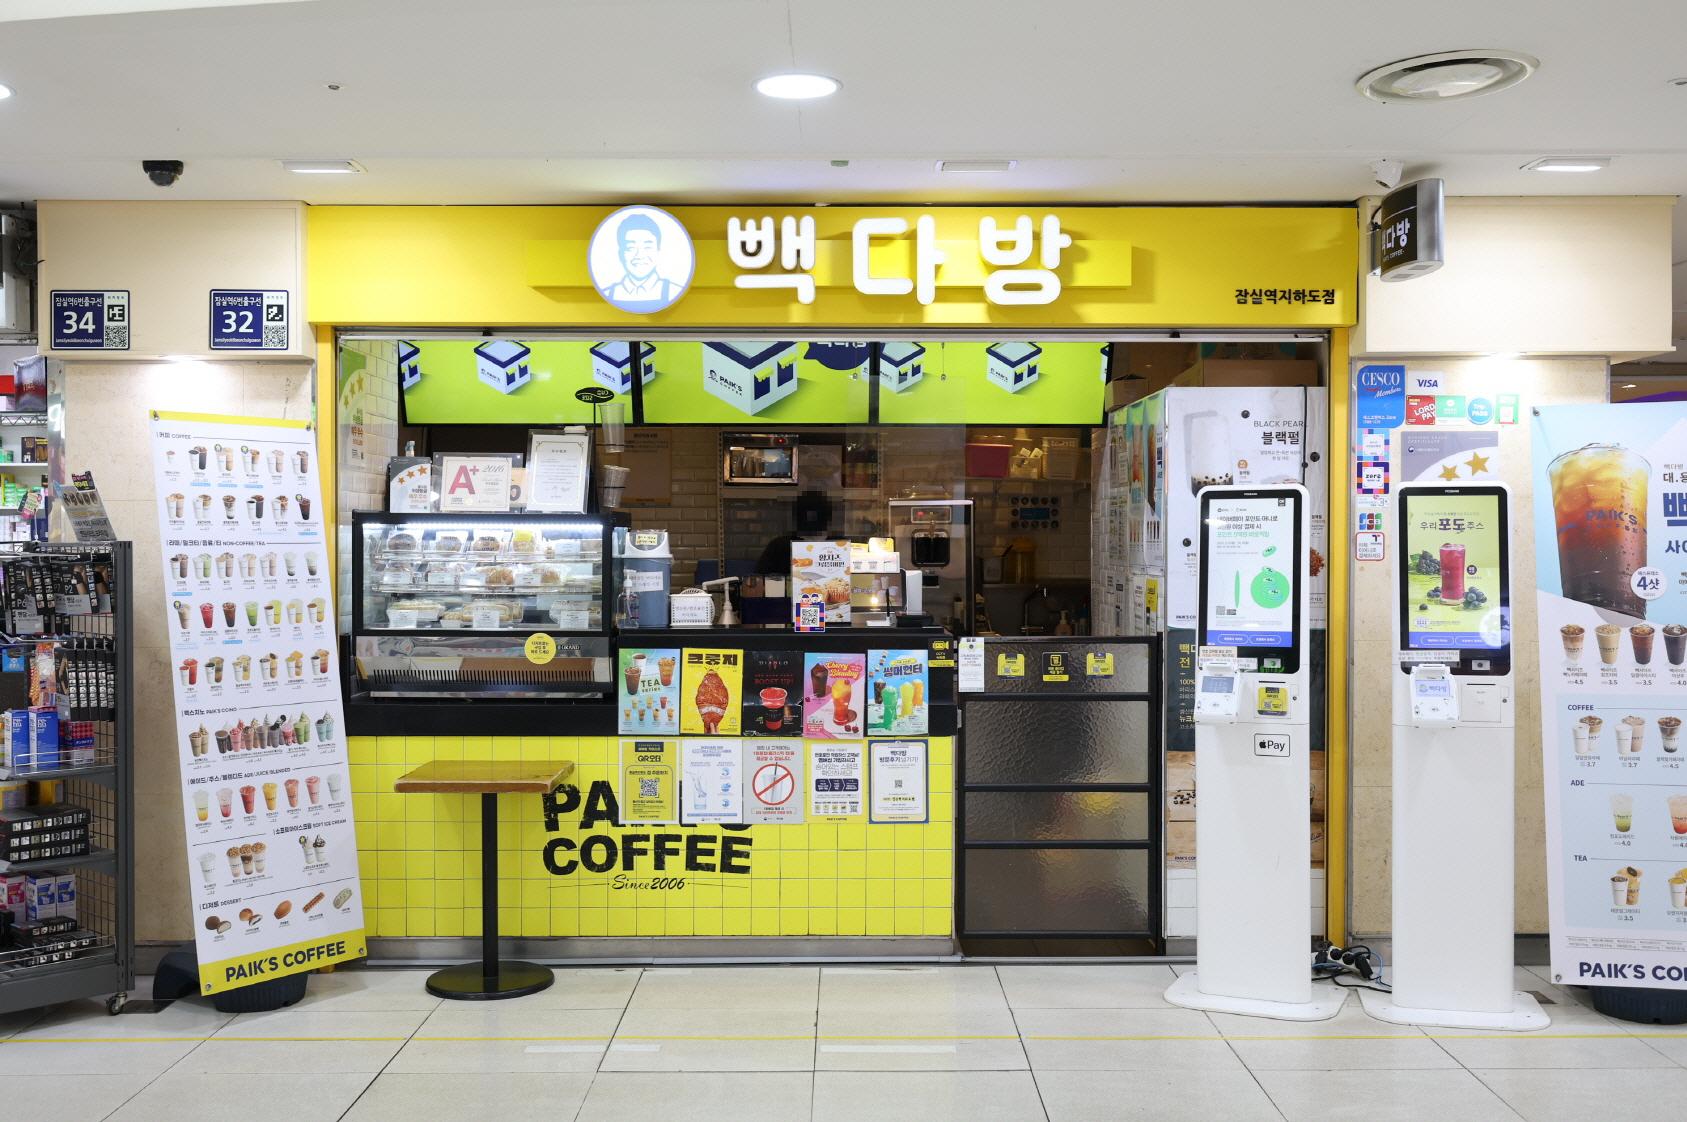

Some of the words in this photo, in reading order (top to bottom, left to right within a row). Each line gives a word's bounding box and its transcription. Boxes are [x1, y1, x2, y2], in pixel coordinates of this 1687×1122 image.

[728, 214, 1072, 305] 빽다방
[1235, 289, 1335, 304] 잠실역지하도점
[63, 311, 96, 334] 34
[222, 311, 254, 333] 32
[719, 375, 743, 392] PAIK'S
[1362, 371, 1400, 386] CESCO
[1417, 378, 1438, 388] VISA
[1414, 404, 1435, 416] LORD
[1422, 411, 1435, 421] PAY
[1261, 431, 1300, 445] 블랙펄
[448, 465, 480, 495] A+
[1585, 508, 1638, 526] PAIK'S
[1420, 522, 1437, 530] 우리
[1438, 519, 1466, 532] 포도
[1467, 522, 1484, 530] 주스
[1637, 577, 1660, 590] 4샷
[641, 679, 660, 688] TEA
[1267, 740, 1285, 751] Pay
[542, 834, 753, 876] COFFEE
[1574, 854, 1587, 862] TEA
[612, 874, 650, 890] Since
[650, 877, 686, 890] 2006
[202, 900, 219, 910] 디저트
[226, 956, 279, 982] PAIK'S
[282, 941, 346, 968] COFFEE
[1579, 962, 1646, 979] PAIK'S
[1652, 965, 1687, 982] CO
